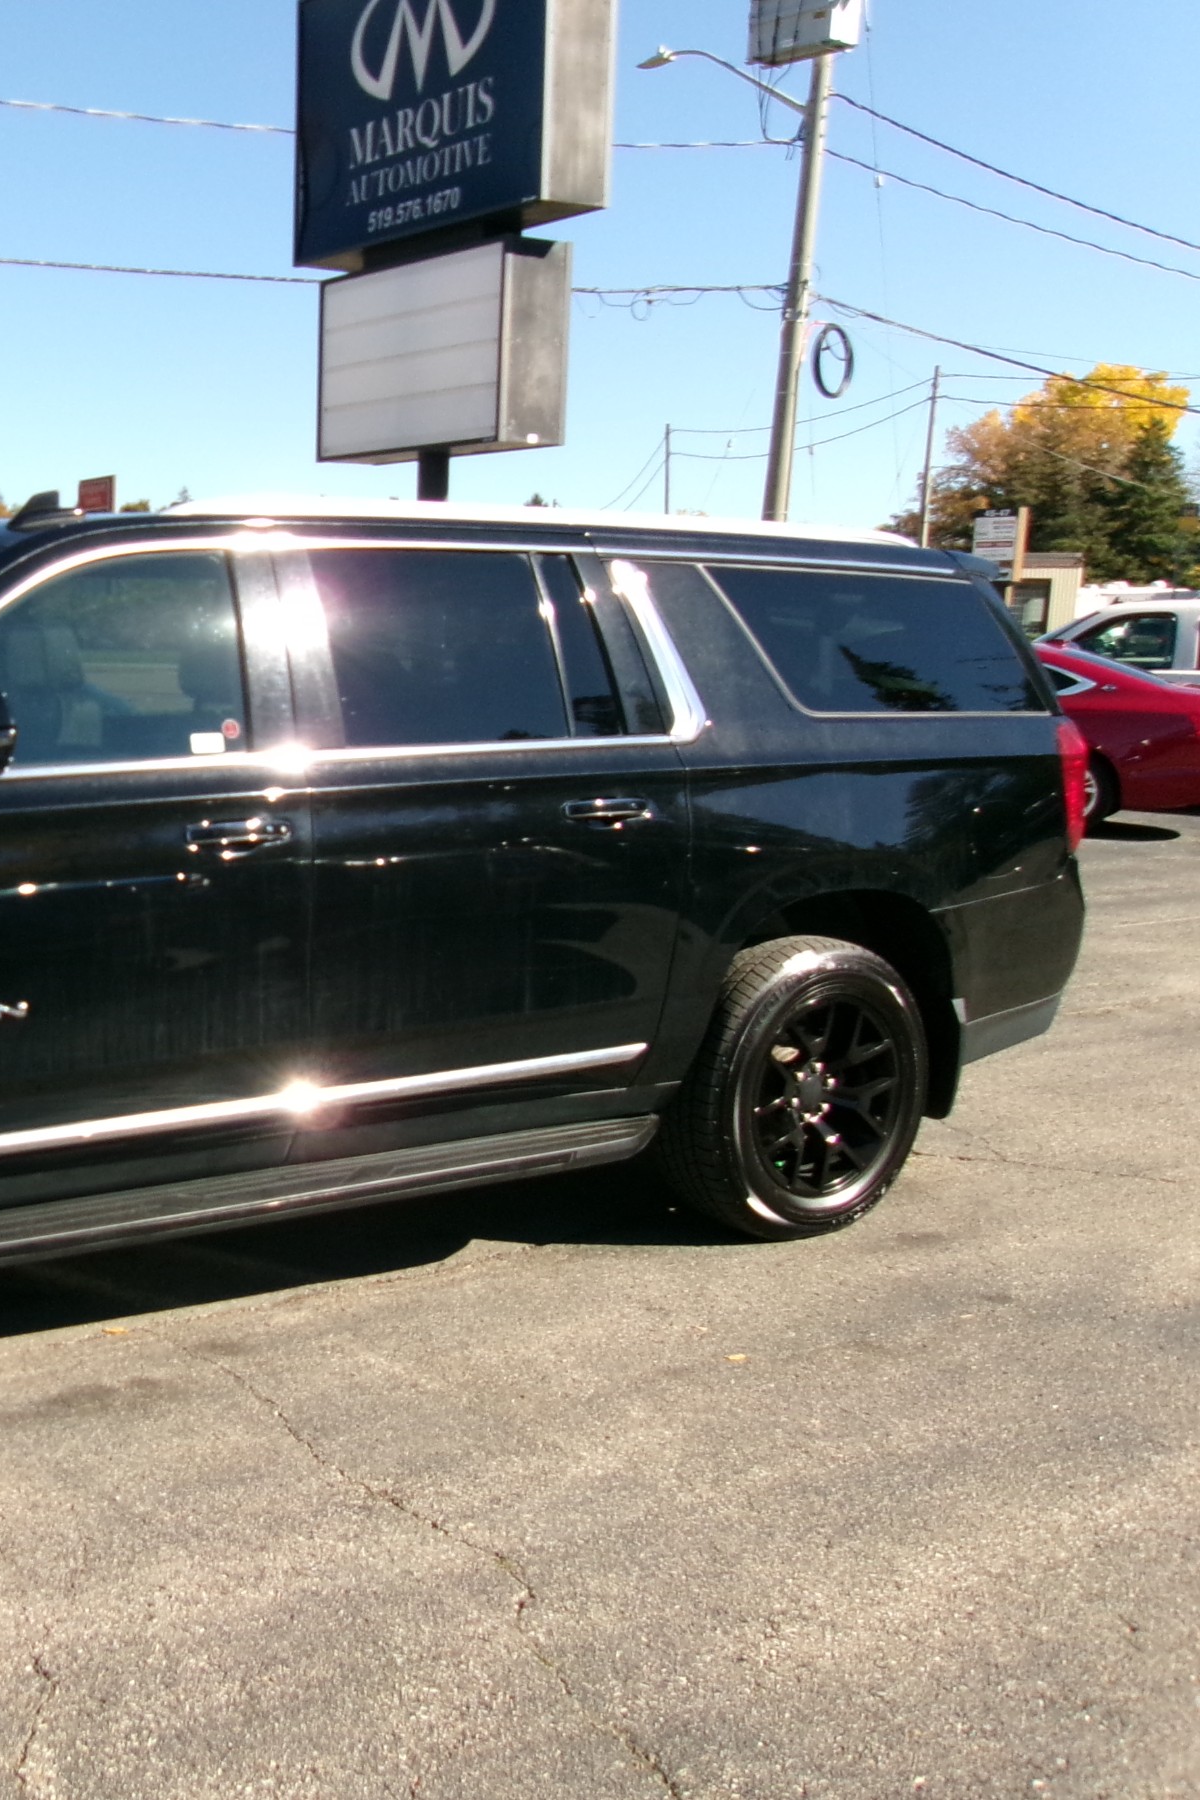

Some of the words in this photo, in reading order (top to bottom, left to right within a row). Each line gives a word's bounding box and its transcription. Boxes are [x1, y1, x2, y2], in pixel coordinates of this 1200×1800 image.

[349, 77, 494, 170] MARQUIS
[346, 134, 492, 206] AUTOMOTIVE
[368, 188, 460, 232] 519.576.1670
